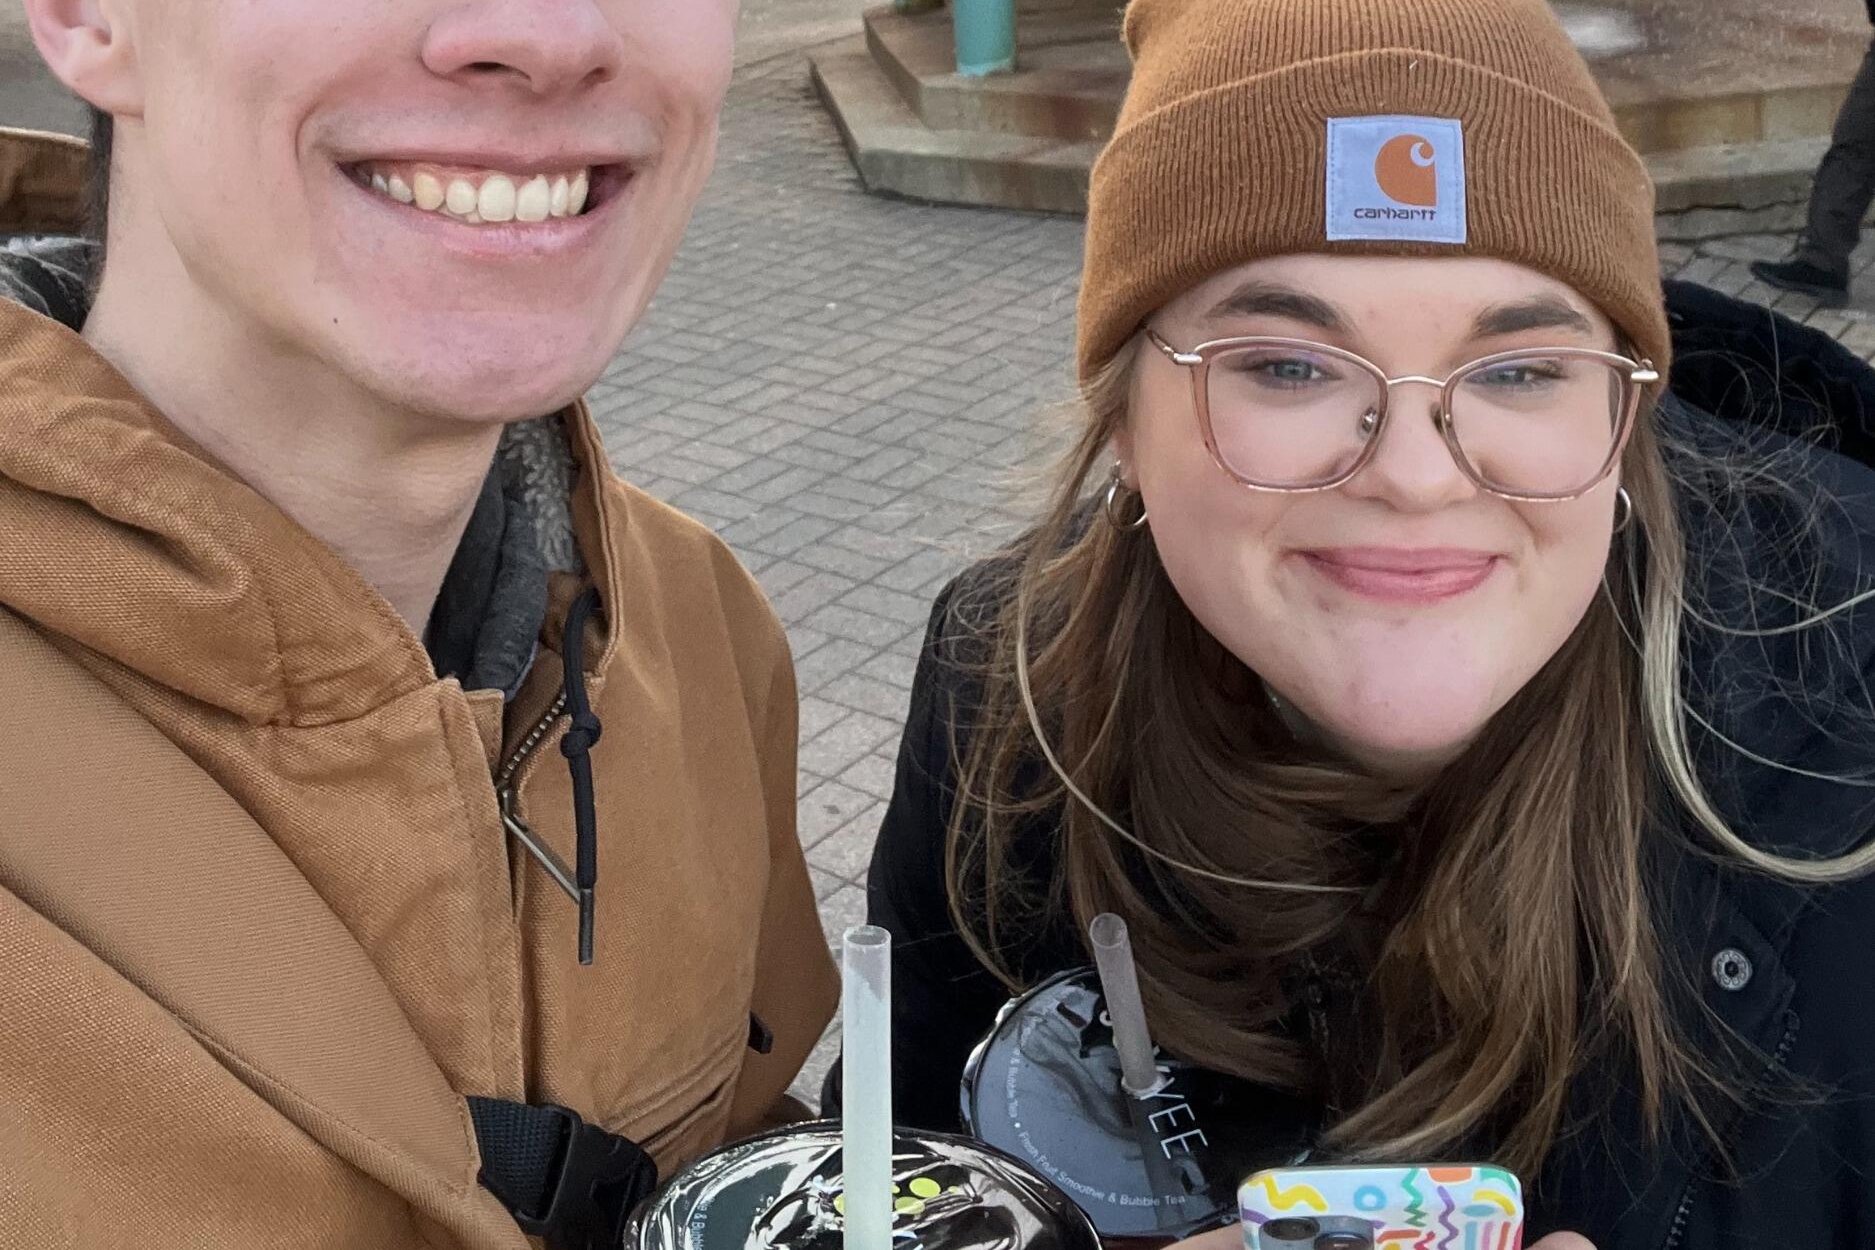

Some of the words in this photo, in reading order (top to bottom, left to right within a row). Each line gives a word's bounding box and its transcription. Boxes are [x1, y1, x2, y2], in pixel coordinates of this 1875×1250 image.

[1353, 207, 1437, 221] carhartt
[1018, 1131, 1039, 1159] Fresh
[1107, 1192, 1116, 1204] &
[1120, 1193, 1160, 1207] Bubble
[1164, 1194, 1186, 1205] Tea
